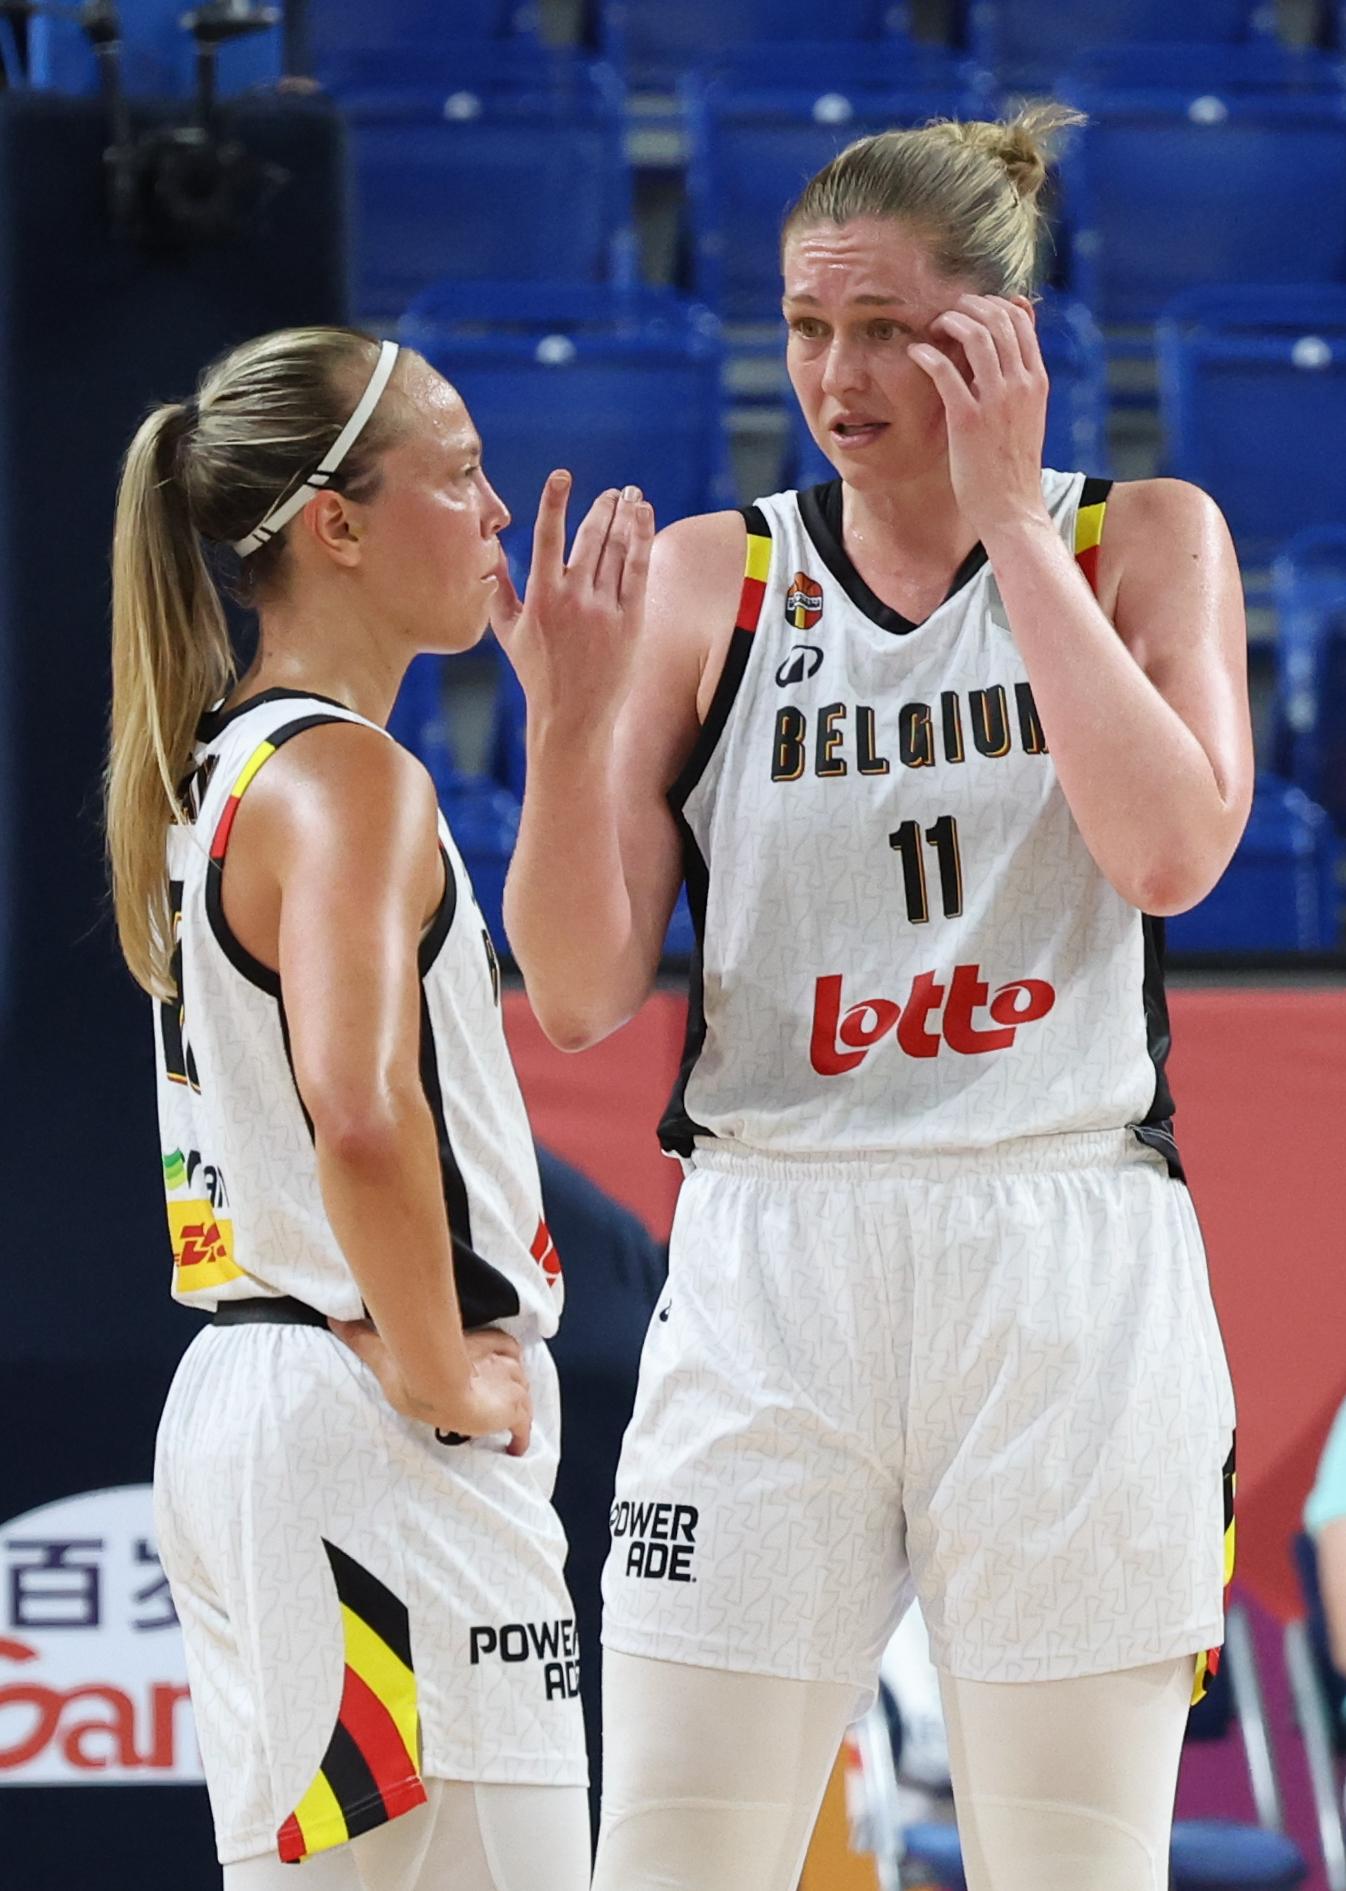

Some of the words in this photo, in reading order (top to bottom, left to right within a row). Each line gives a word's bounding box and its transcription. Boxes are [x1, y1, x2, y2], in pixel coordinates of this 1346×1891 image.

[889, 815, 963, 924] 11
[810, 964, 1056, 1076] lotto
[470, 1619, 579, 1665] POWE
